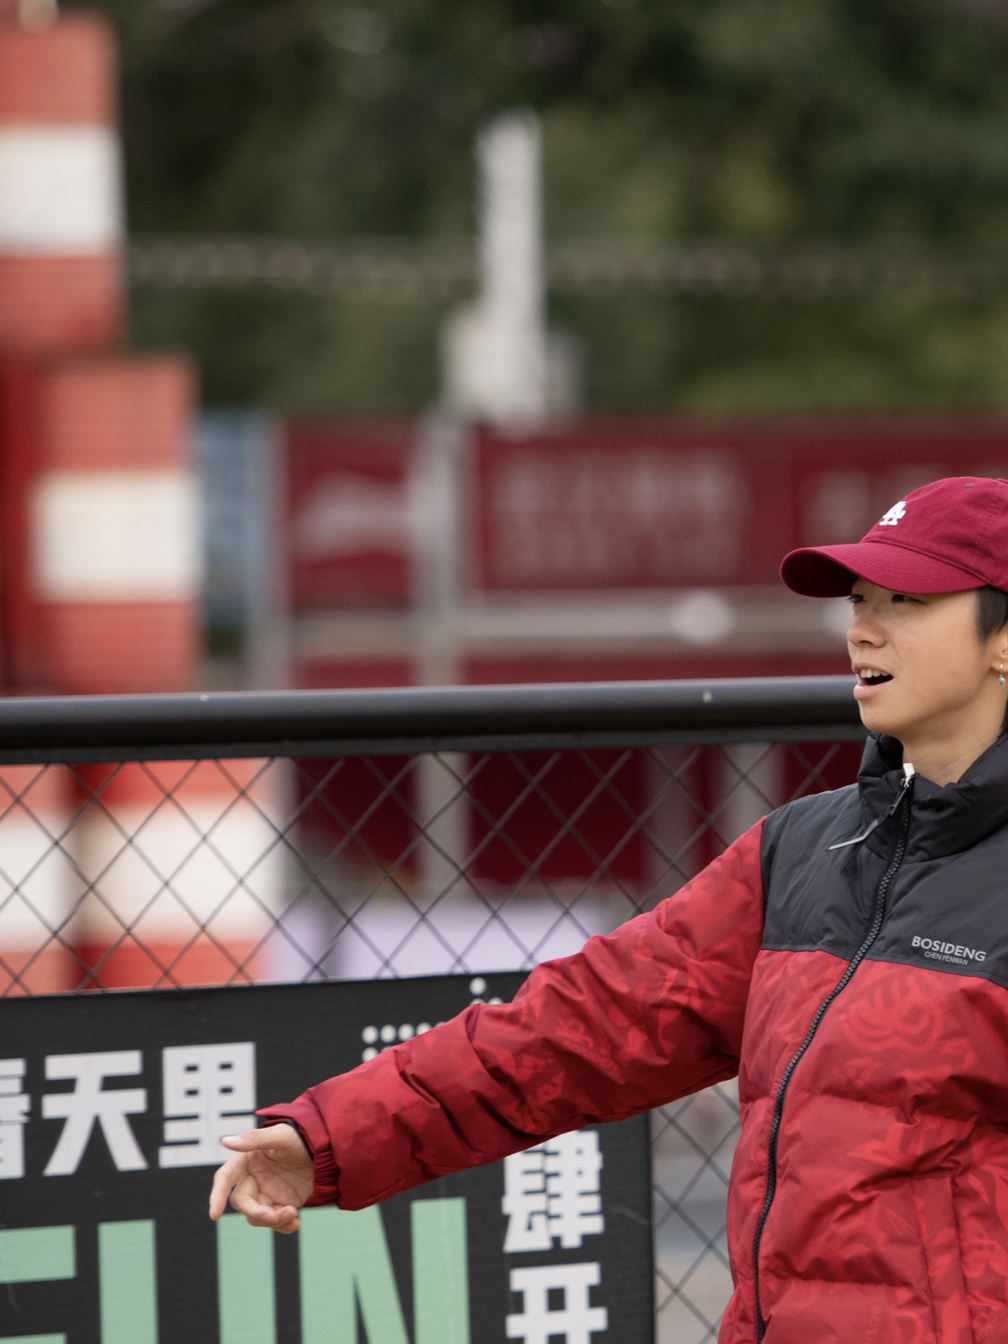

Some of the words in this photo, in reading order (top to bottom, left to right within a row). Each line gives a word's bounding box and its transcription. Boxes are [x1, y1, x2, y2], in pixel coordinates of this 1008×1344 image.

[911, 935, 987, 962] BOSIDENG
[924, 951, 942, 960] CHEN
[942, 954, 969, 966] FENWAN
